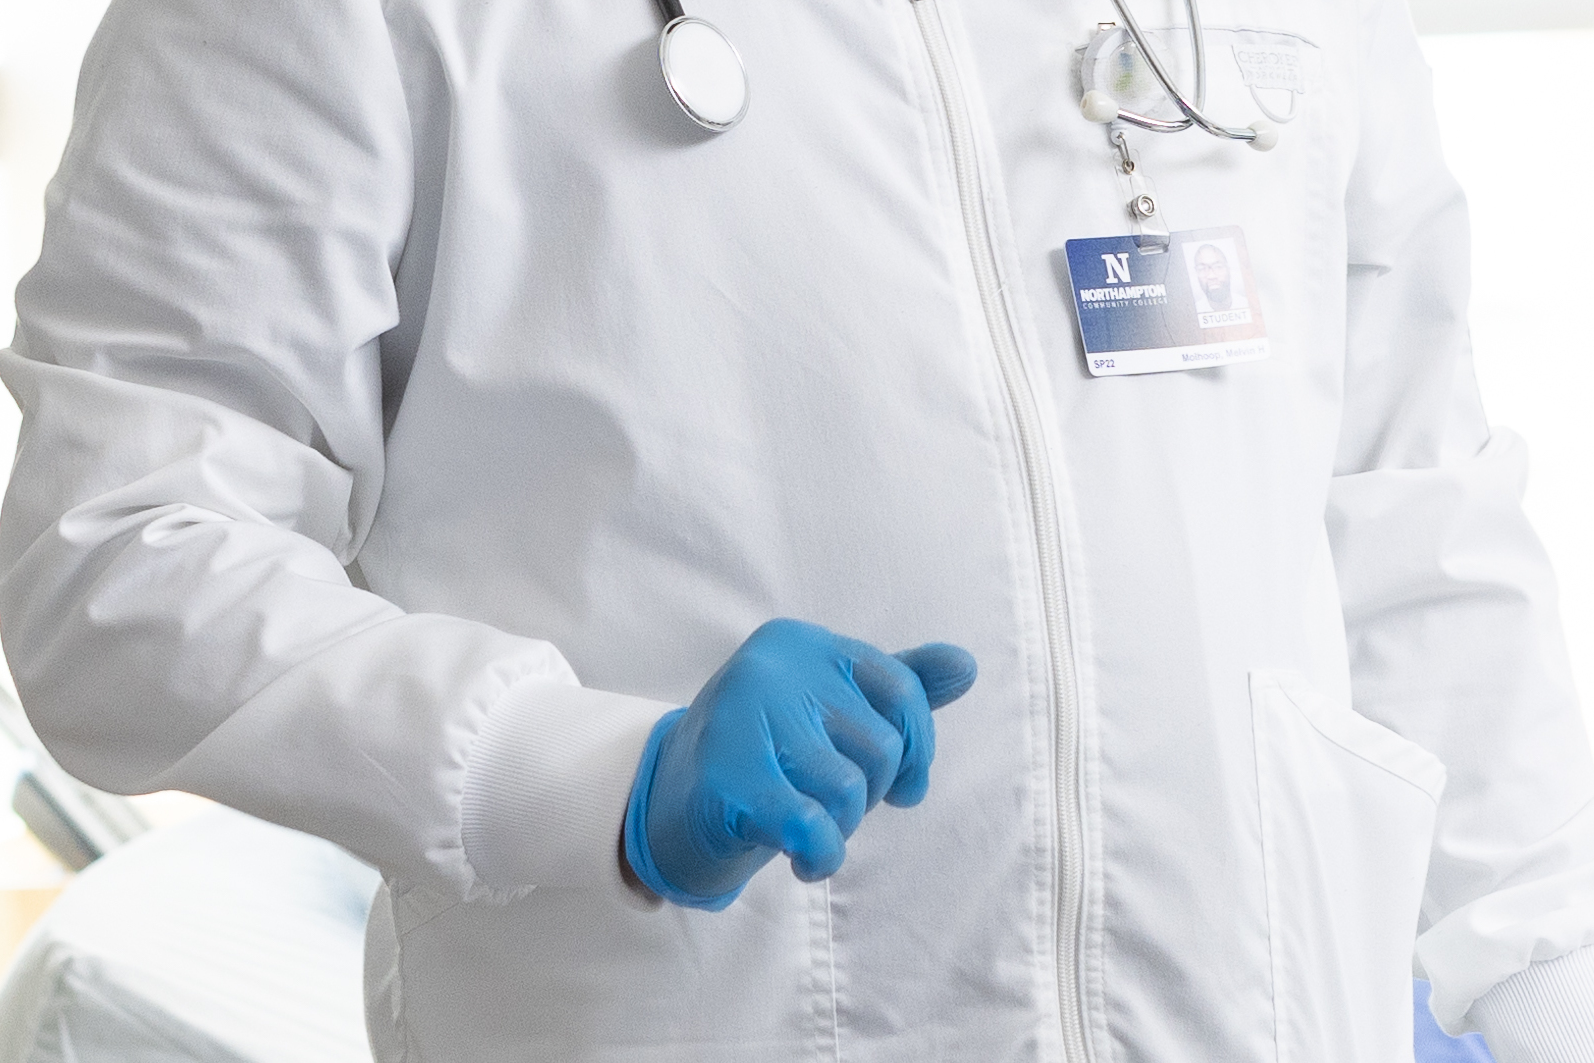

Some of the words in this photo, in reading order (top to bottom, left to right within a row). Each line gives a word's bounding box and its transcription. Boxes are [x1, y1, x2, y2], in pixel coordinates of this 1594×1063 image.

[1101, 252, 1132, 284] N
[1080, 283, 1167, 302] NORTHAMPTON
[1082, 300, 1129, 310] COMMUNITY
[1133, 297, 1169, 307] COLLEGE
[1202, 311, 1247, 325] STUDENT
[1094, 359, 1116, 369] SP22
